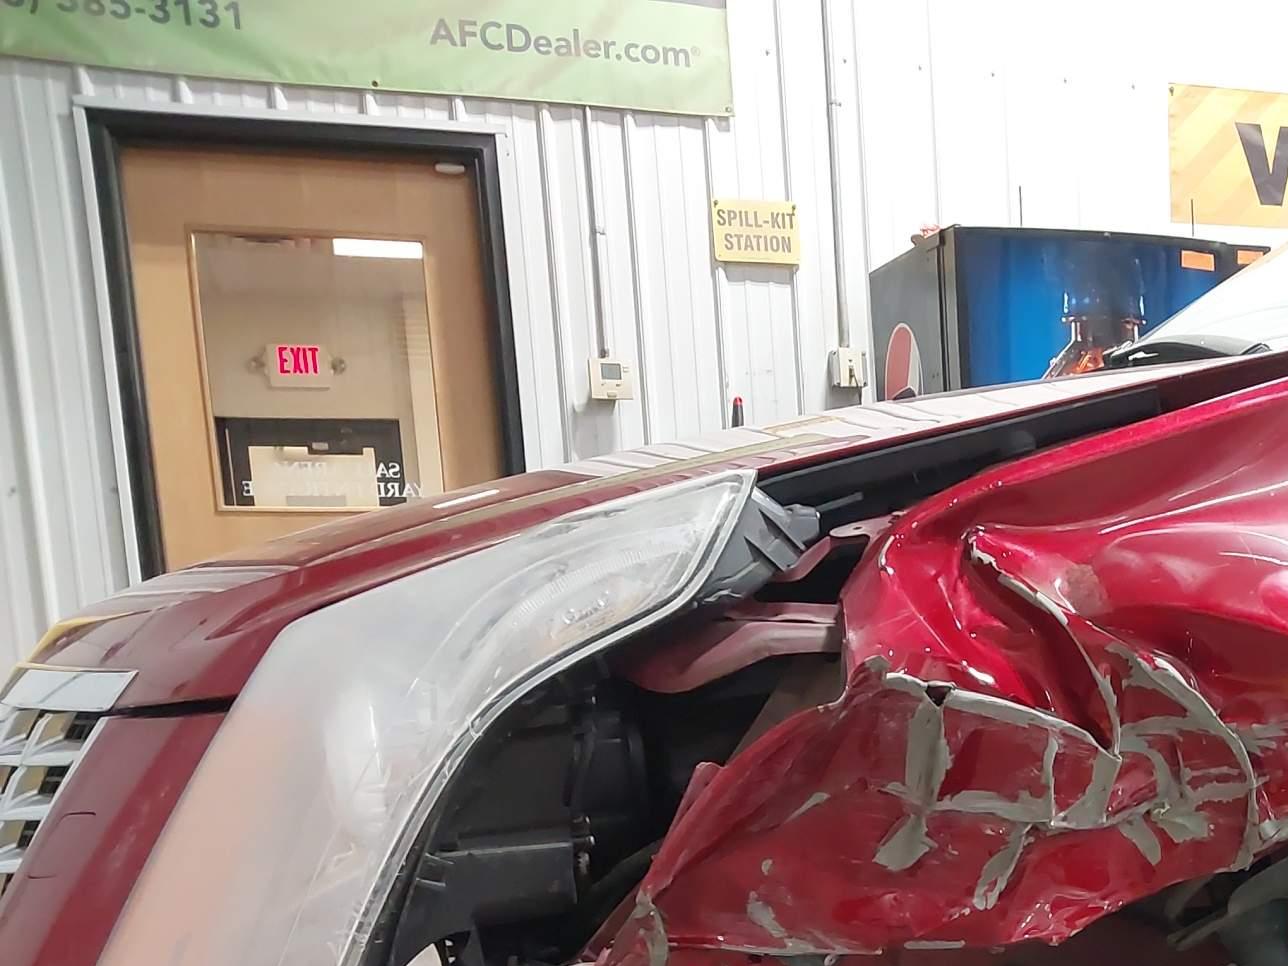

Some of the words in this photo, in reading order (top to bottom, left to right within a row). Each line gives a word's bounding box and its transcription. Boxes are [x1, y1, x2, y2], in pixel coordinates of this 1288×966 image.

[716, 208, 795, 230] SPILL-KIT
[724, 233, 792, 253] STATION
[278, 346, 319, 374] EXIT
